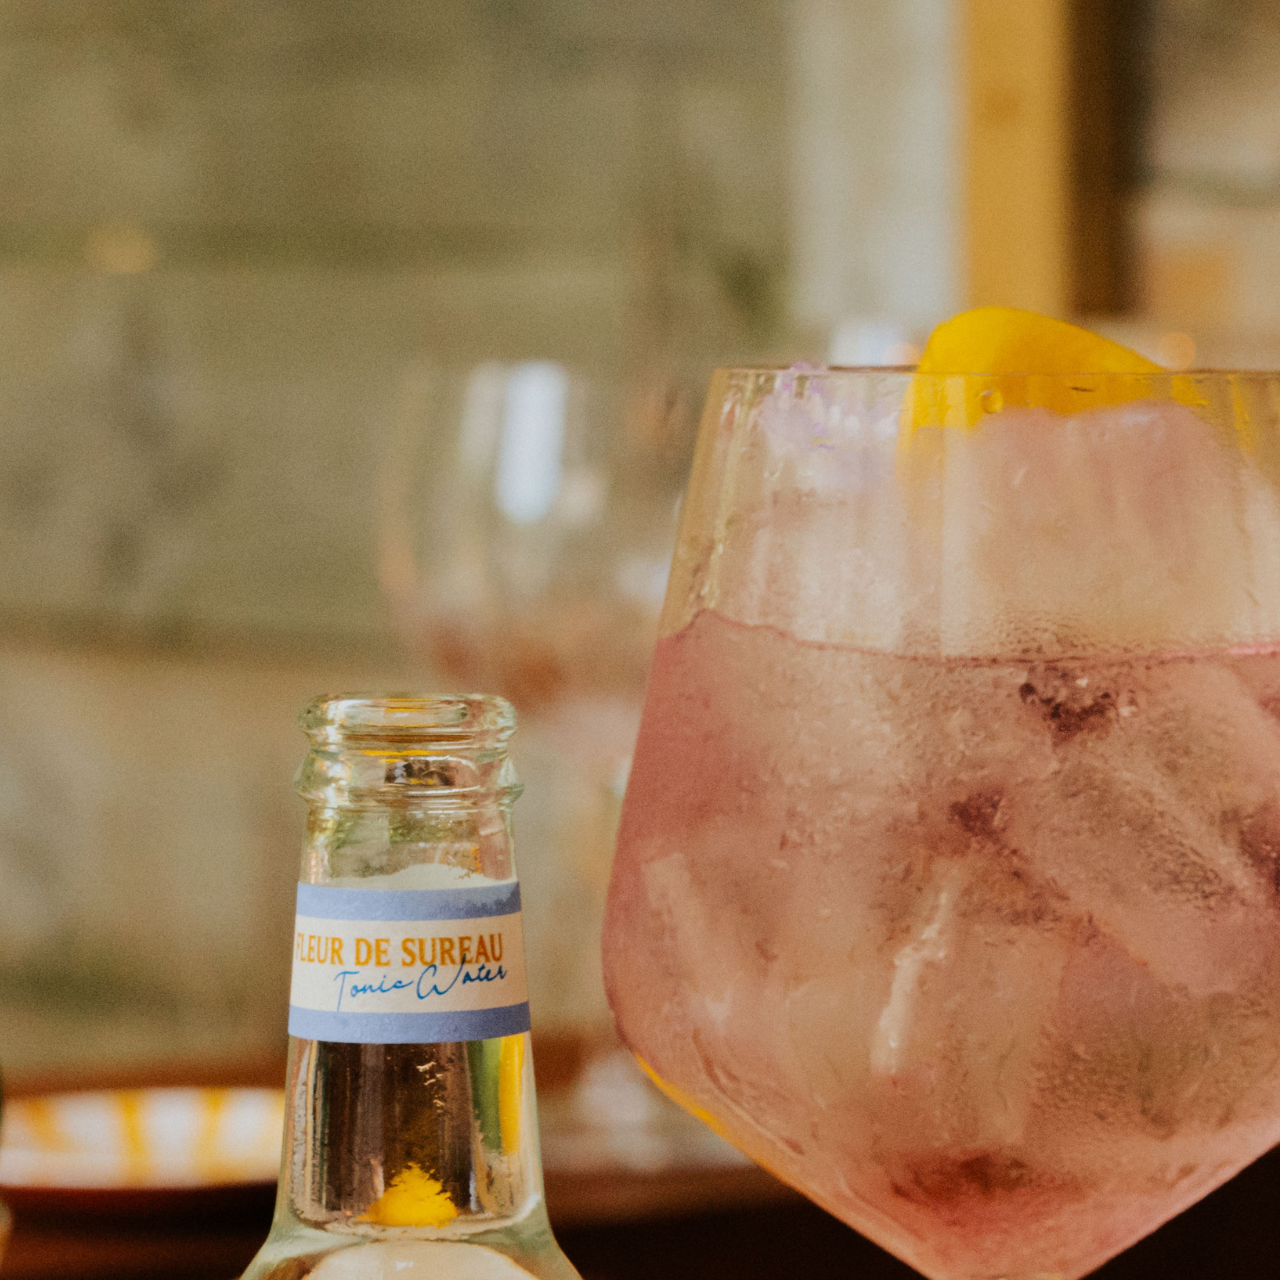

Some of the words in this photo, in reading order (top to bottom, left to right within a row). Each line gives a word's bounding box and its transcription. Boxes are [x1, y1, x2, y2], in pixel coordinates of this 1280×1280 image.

[354, 938, 391, 967] DE
[401, 933, 503, 967] SUREAU
[333, 970, 413, 1012] Tonic
[416, 953, 508, 999] Water
